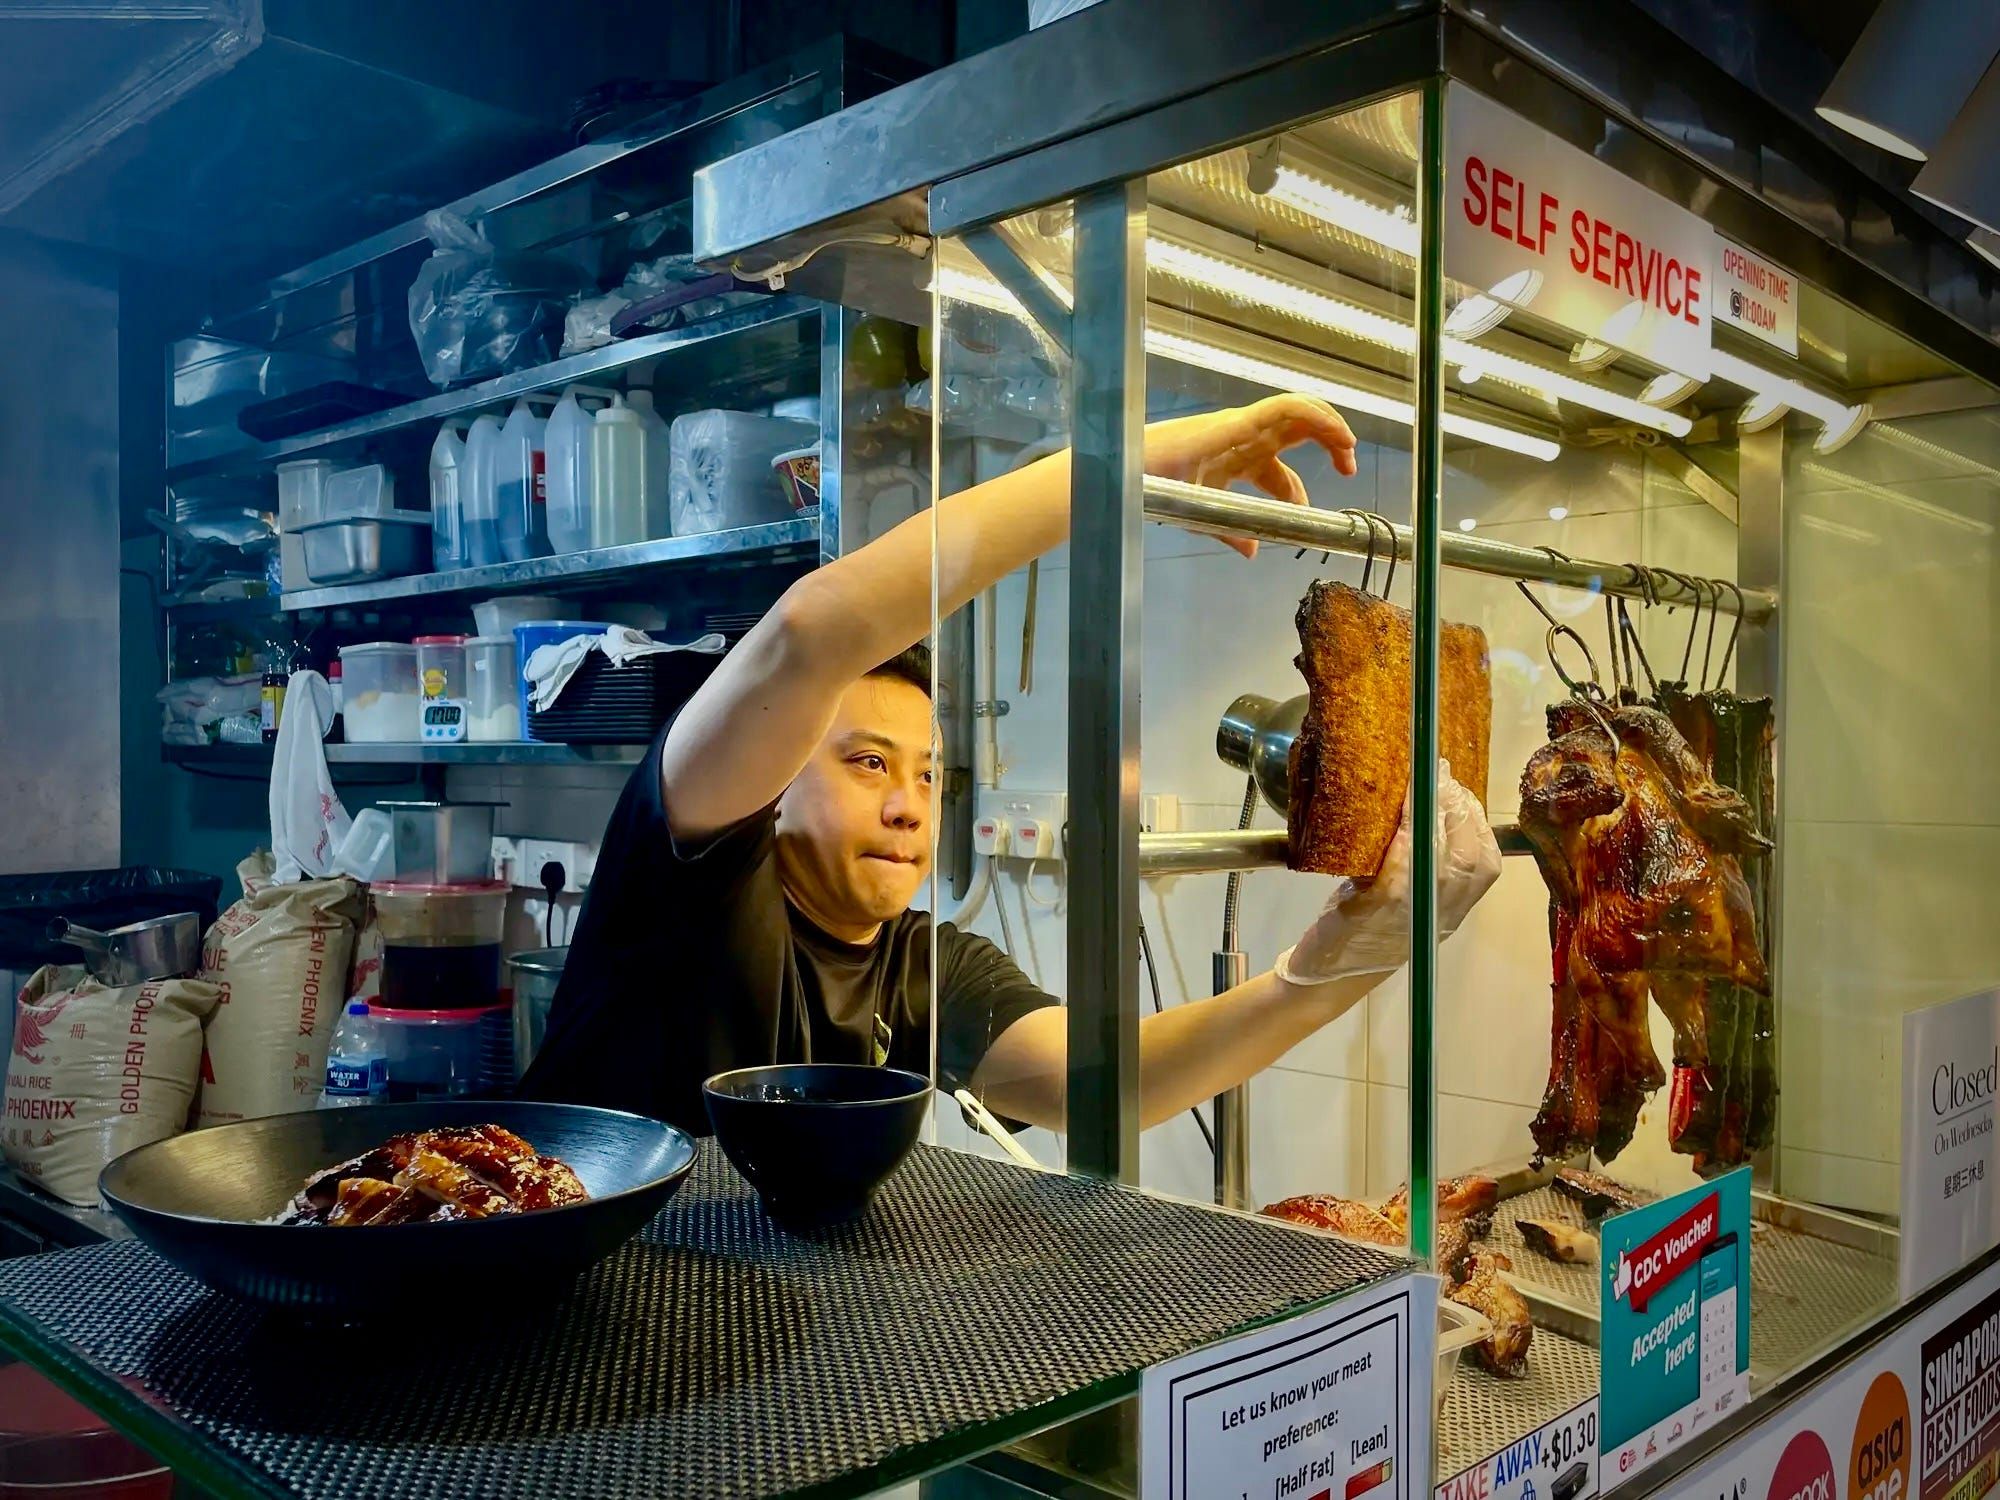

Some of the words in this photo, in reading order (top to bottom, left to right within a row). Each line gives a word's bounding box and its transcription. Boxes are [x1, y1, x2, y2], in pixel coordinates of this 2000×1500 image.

[1463, 156, 1559, 256] SELF
[1569, 210, 1701, 326] SERVICE
[1723, 248, 1766, 291] OPENING
[1768, 271, 1789, 304] TIME
[1741, 296, 1777, 334] 11:00AM
[298, 958, 322, 1037] PHOENIX
[29, 1075, 52, 1090] RICE
[119, 1041, 146, 1114] GOLDEN
[330, 1071, 360, 1080] WATER
[1932, 1044, 1998, 1116] Closed
[7, 1098, 76, 1120] PHOENIX
[1934, 1132, 1949, 1156] On
[1950, 1115, 1993, 1149] Wednesday
[1943, 1159, 1985, 1200] 星期三休息
[1634, 1248, 1662, 1289] CDC
[1664, 1212, 1713, 1265] Voucher
[1631, 1289, 1696, 1368] Accepted
[1664, 1331, 1696, 1376] here
[1222, 1406, 1246, 1431] Let
[1250, 1400, 1267, 1420] us
[1270, 1381, 1308, 1413] know
[1311, 1369, 1340, 1399] your
[1342, 1351, 1372, 1381] meat
[1924, 1310, 2000, 1415] SINGAPOR
[1263, 1409, 1339, 1462] preference:
[1926, 1398, 1961, 1471] BEST
[1964, 1362, 2000, 1437] FOODS
[1275, 1464, 1308, 1500] [Half
[1310, 1450, 1334, 1482] Fat]
[1351, 1424, 1388, 1465] [Lean]
[1494, 1431, 1542, 1491] AWAY
[1857, 1415, 1904, 1489] asia
[1948, 1431, 1983, 1483] ENJOY
